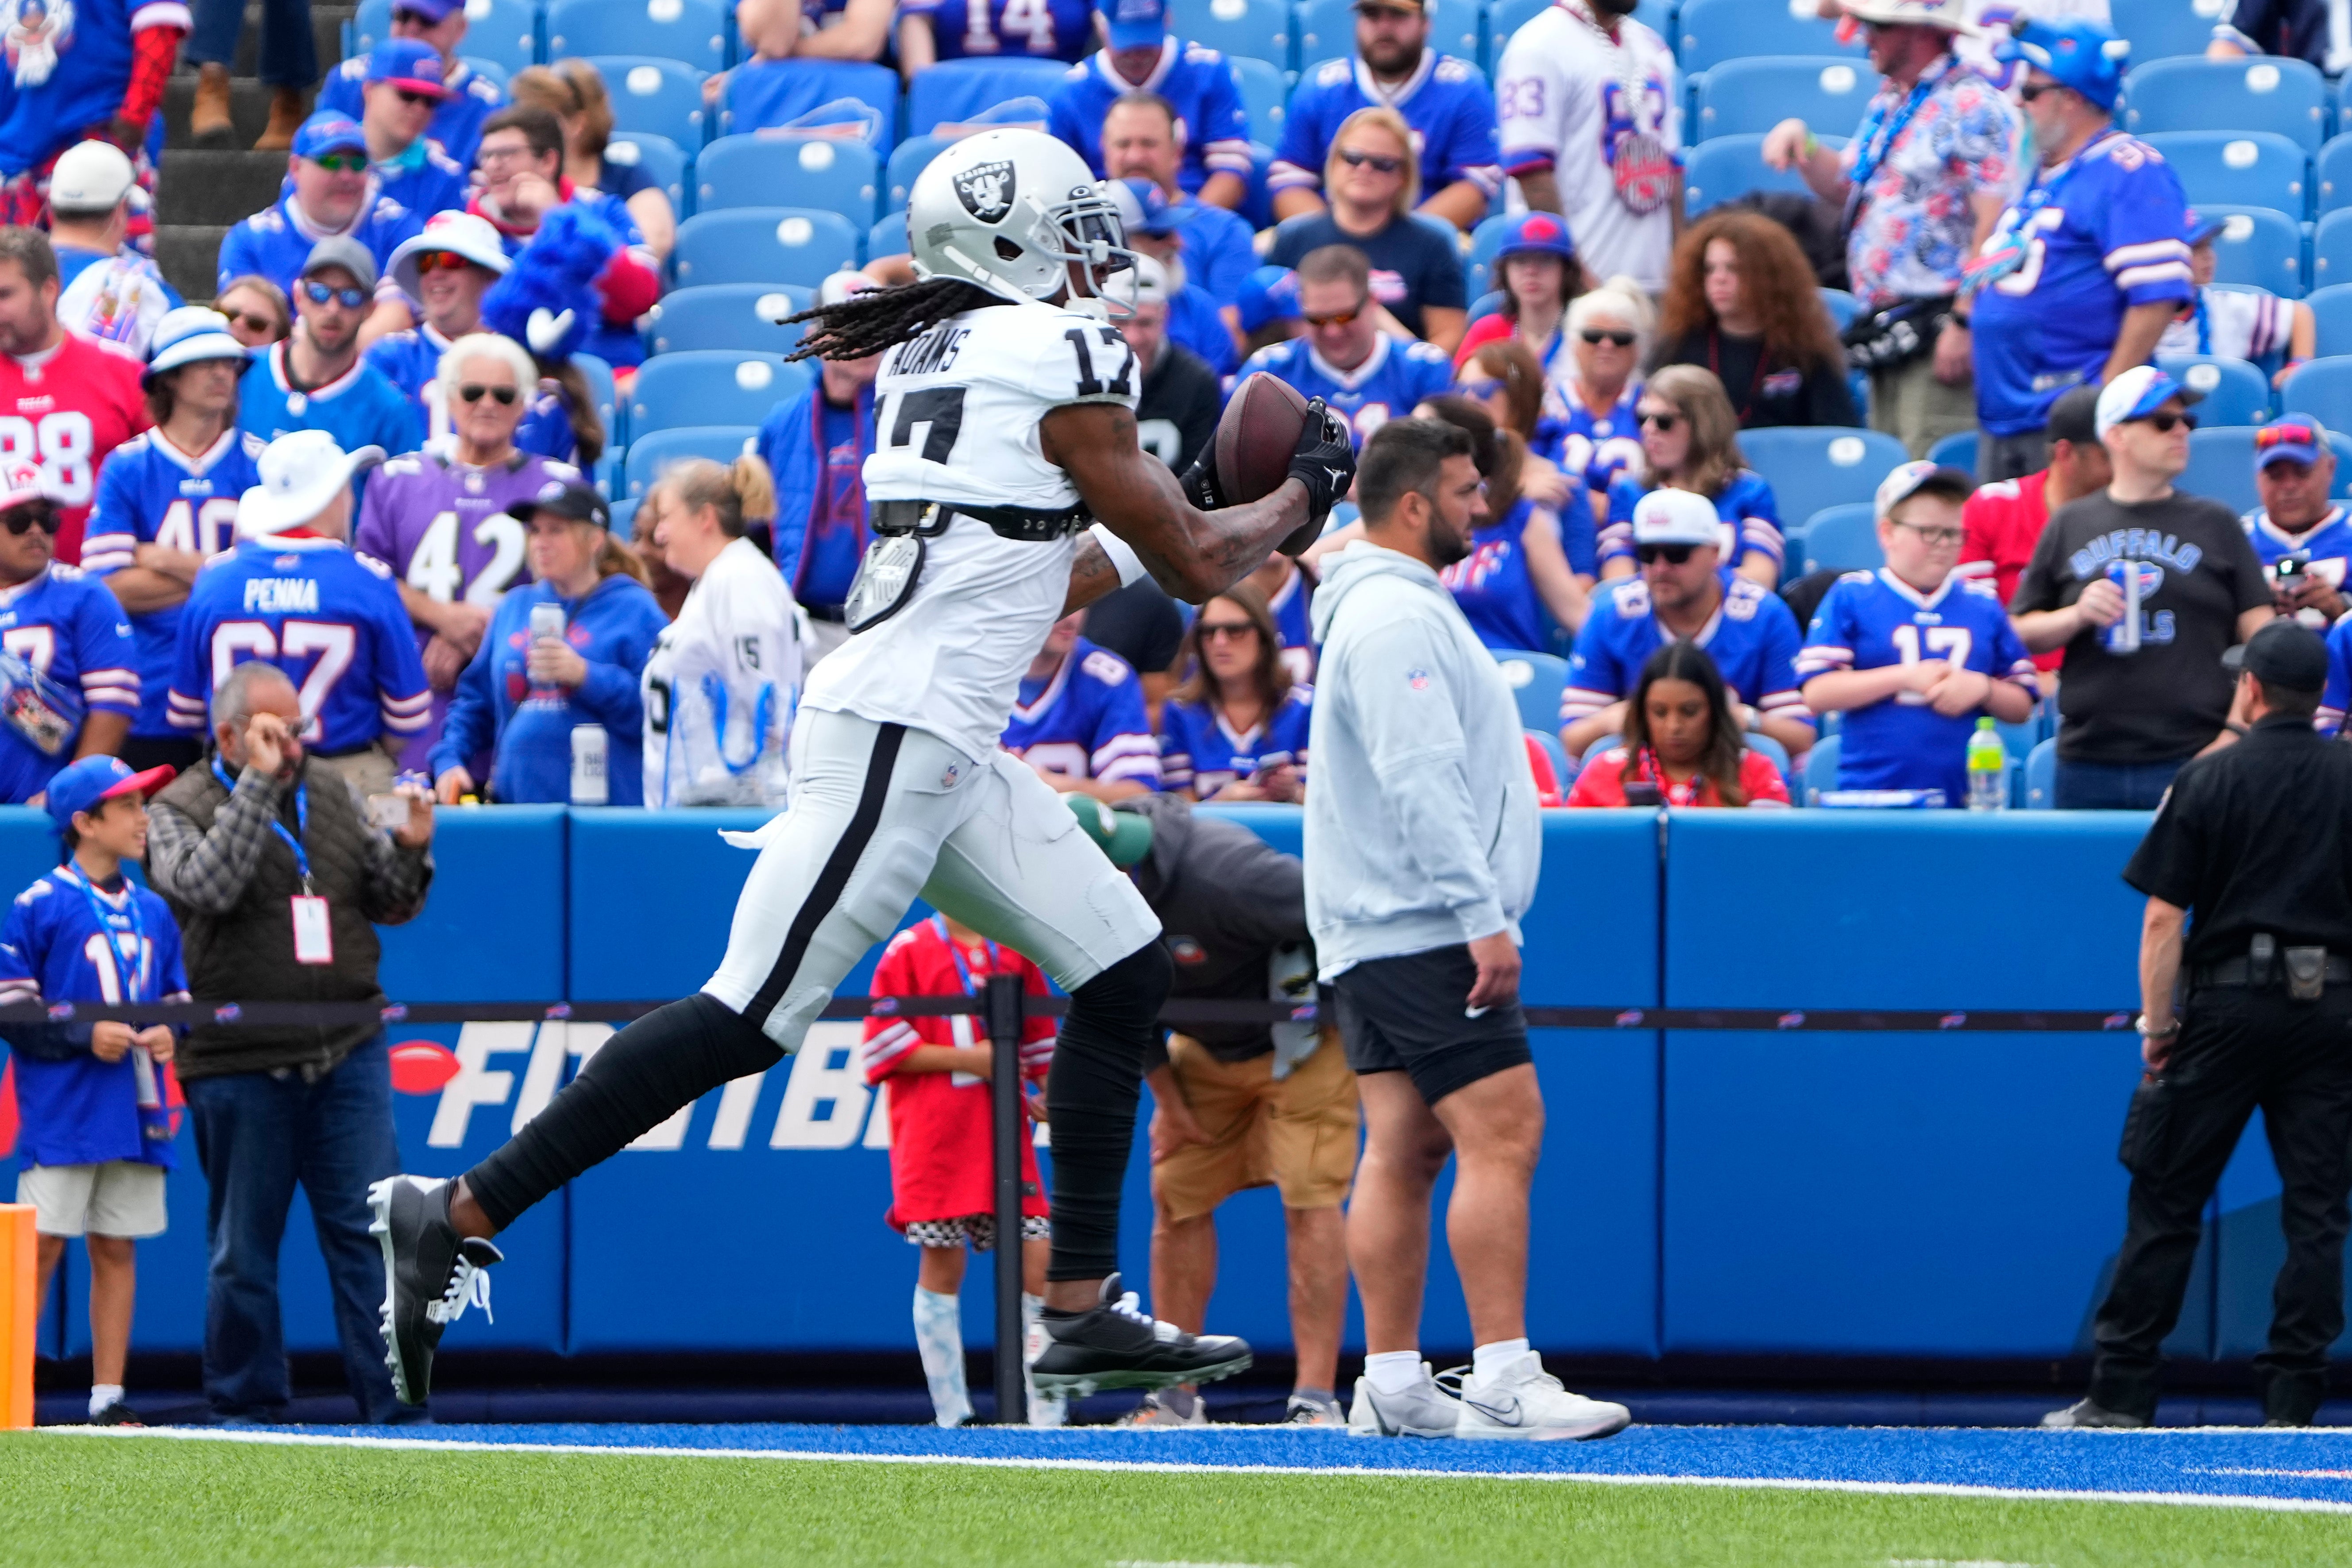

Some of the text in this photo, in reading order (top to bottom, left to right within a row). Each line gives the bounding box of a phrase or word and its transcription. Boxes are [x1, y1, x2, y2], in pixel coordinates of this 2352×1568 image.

[962, 0, 1057, 54] 14
[955, 161, 1011, 183] RAIDERS
[888, 328, 971, 377] ADAMS
[1064, 326, 1134, 397] 17
[875, 386, 968, 466] 7
[406, 511, 527, 608] 42
[2069, 527, 2203, 581] BUFFALO
[244, 577, 321, 614] PENNA
[211, 620, 355, 744] 67
[1891, 623, 1972, 706] 17
[85, 932, 153, 1004] 17
